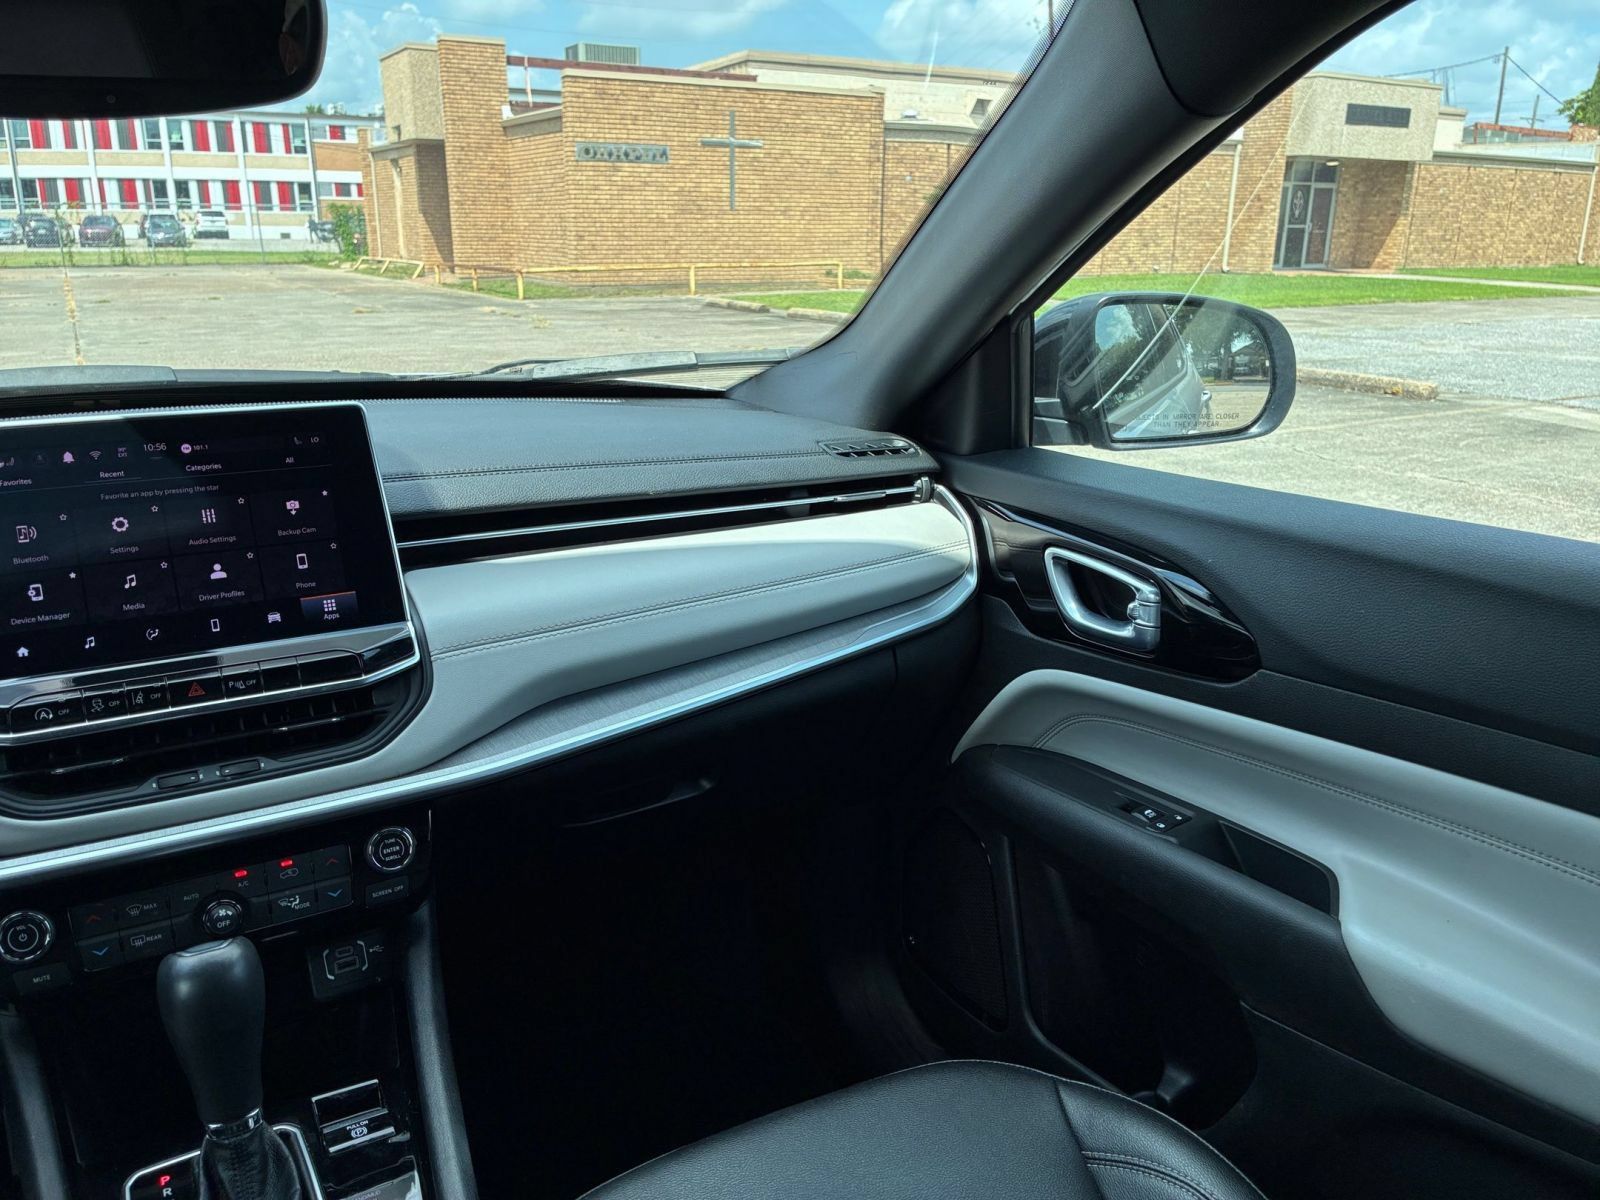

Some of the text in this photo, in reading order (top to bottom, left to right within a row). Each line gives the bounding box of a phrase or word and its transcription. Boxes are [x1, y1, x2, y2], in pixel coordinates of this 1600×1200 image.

[143, 442, 167, 452] 10:56
[285, 456, 295, 464] All
[185, 462, 222, 472] Categories
[99, 471, 124, 479] Recent
[0, 477, 32, 486] Favorites
[100, 493, 129, 501] Favorite
[141, 490, 154, 499] app
[155, 488, 163, 497] by
[164, 486, 193, 496] pressing
[194, 485, 206, 493] the
[277, 526, 317, 536] Backup Cam
[188, 534, 236, 546] Audio Settings
[110, 545, 139, 555] Settings
[13, 554, 49, 565] Bluetooth
[295, 581, 316, 589] Phone
[199, 590, 245, 602] Driver Profiles
[122, 602, 145, 611] Media
[11, 612, 71, 626] Device Manager
[323, 612, 340, 621] Apps
[150, 692, 162, 700] OFF
[108, 699, 120, 708] OFF
[58, 708, 69, 716] OFF
[383, 845, 400, 854] ENTER
[238, 880, 249, 888] A/C
[371, 885, 404, 898] SCREEN OFF
[183, 893, 200, 901] AUTO
[143, 903, 158, 911] MAX
[294, 901, 311, 910] MODE
[216, 919, 231, 929] OFF
[146, 933, 163, 942] REAR
[32, 974, 51, 984] MUTE
[346, 1122, 360, 1131] PULL
[160, 1175, 170, 1186] P
[162, 1187, 173, 1198] R
